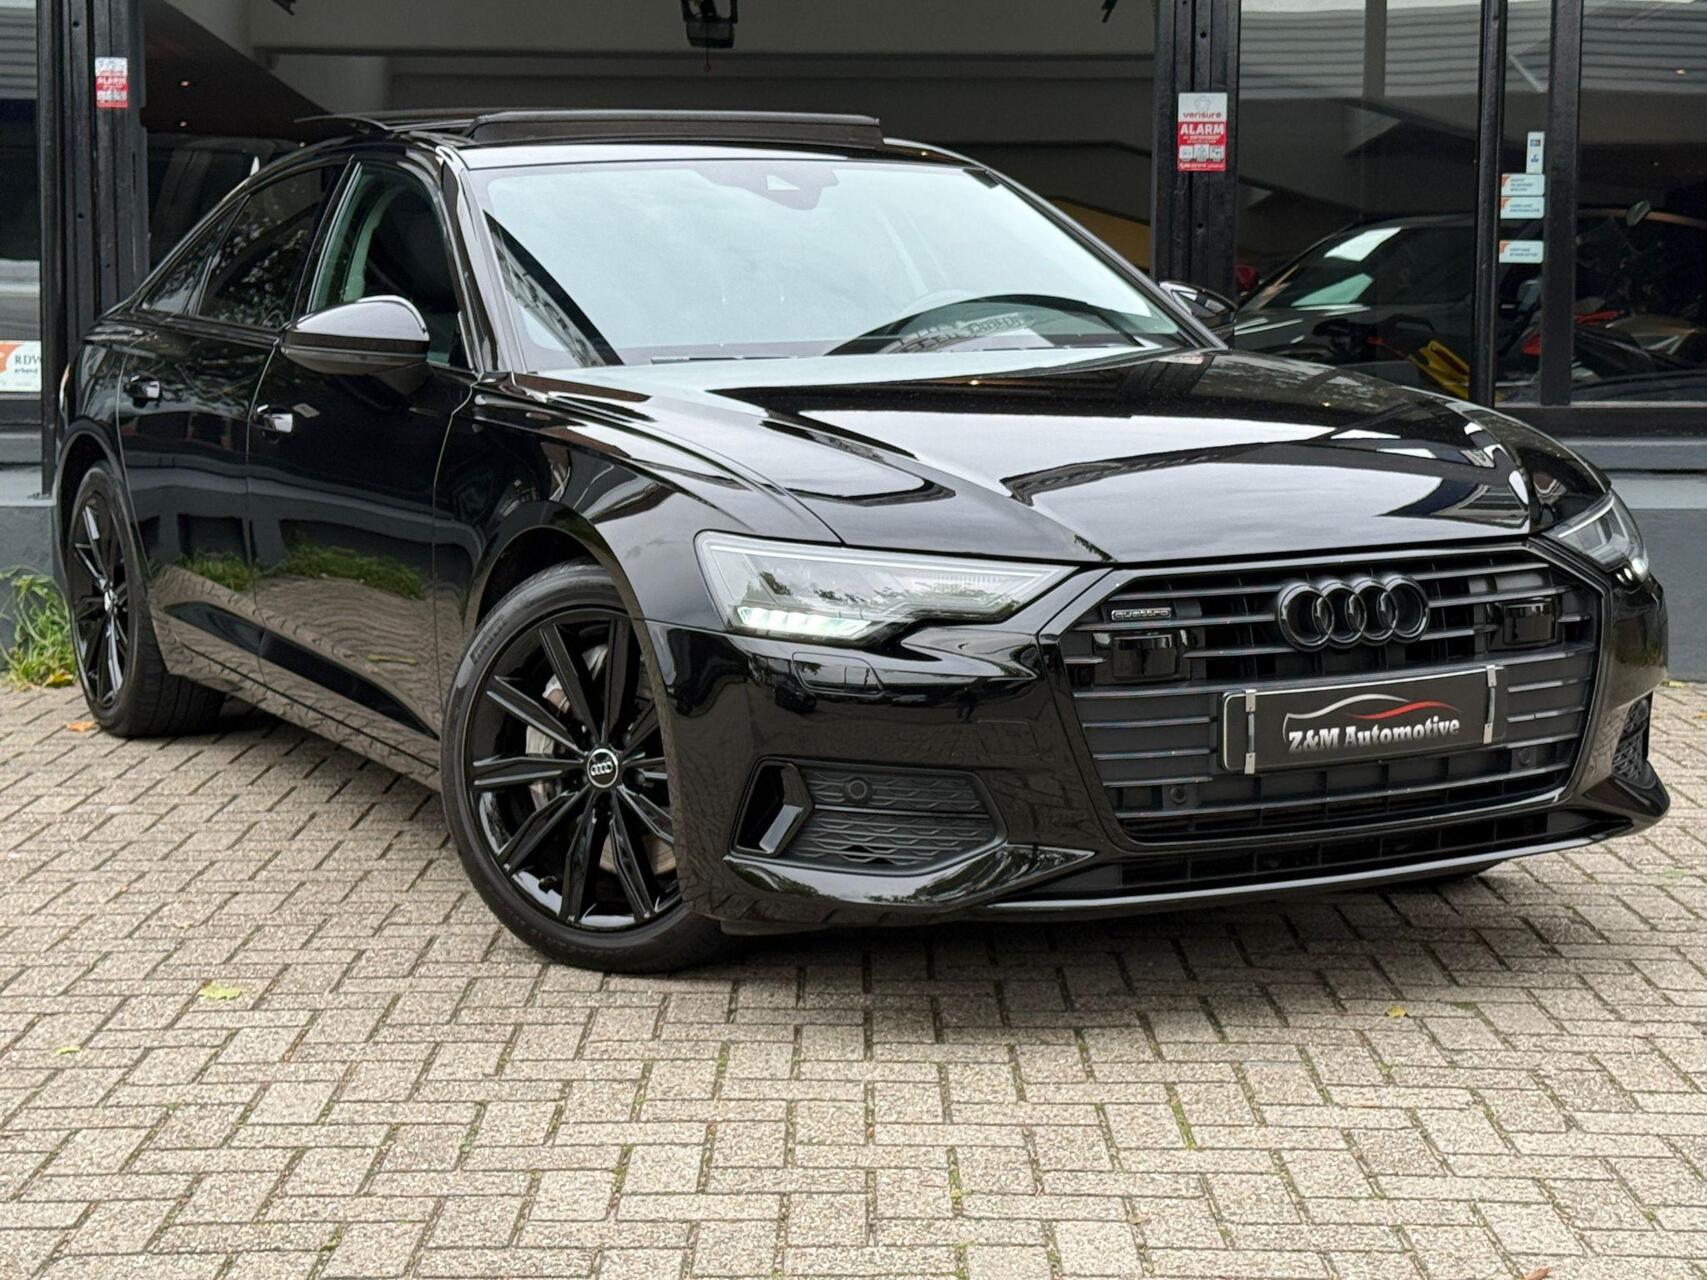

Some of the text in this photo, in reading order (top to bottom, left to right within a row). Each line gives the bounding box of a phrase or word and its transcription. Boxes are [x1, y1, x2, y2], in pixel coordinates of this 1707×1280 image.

[1180, 123, 1225, 135] ALARM
[1114, 609, 1170, 620] quattro
[1288, 715, 1461, 752] Z&M Automotive
